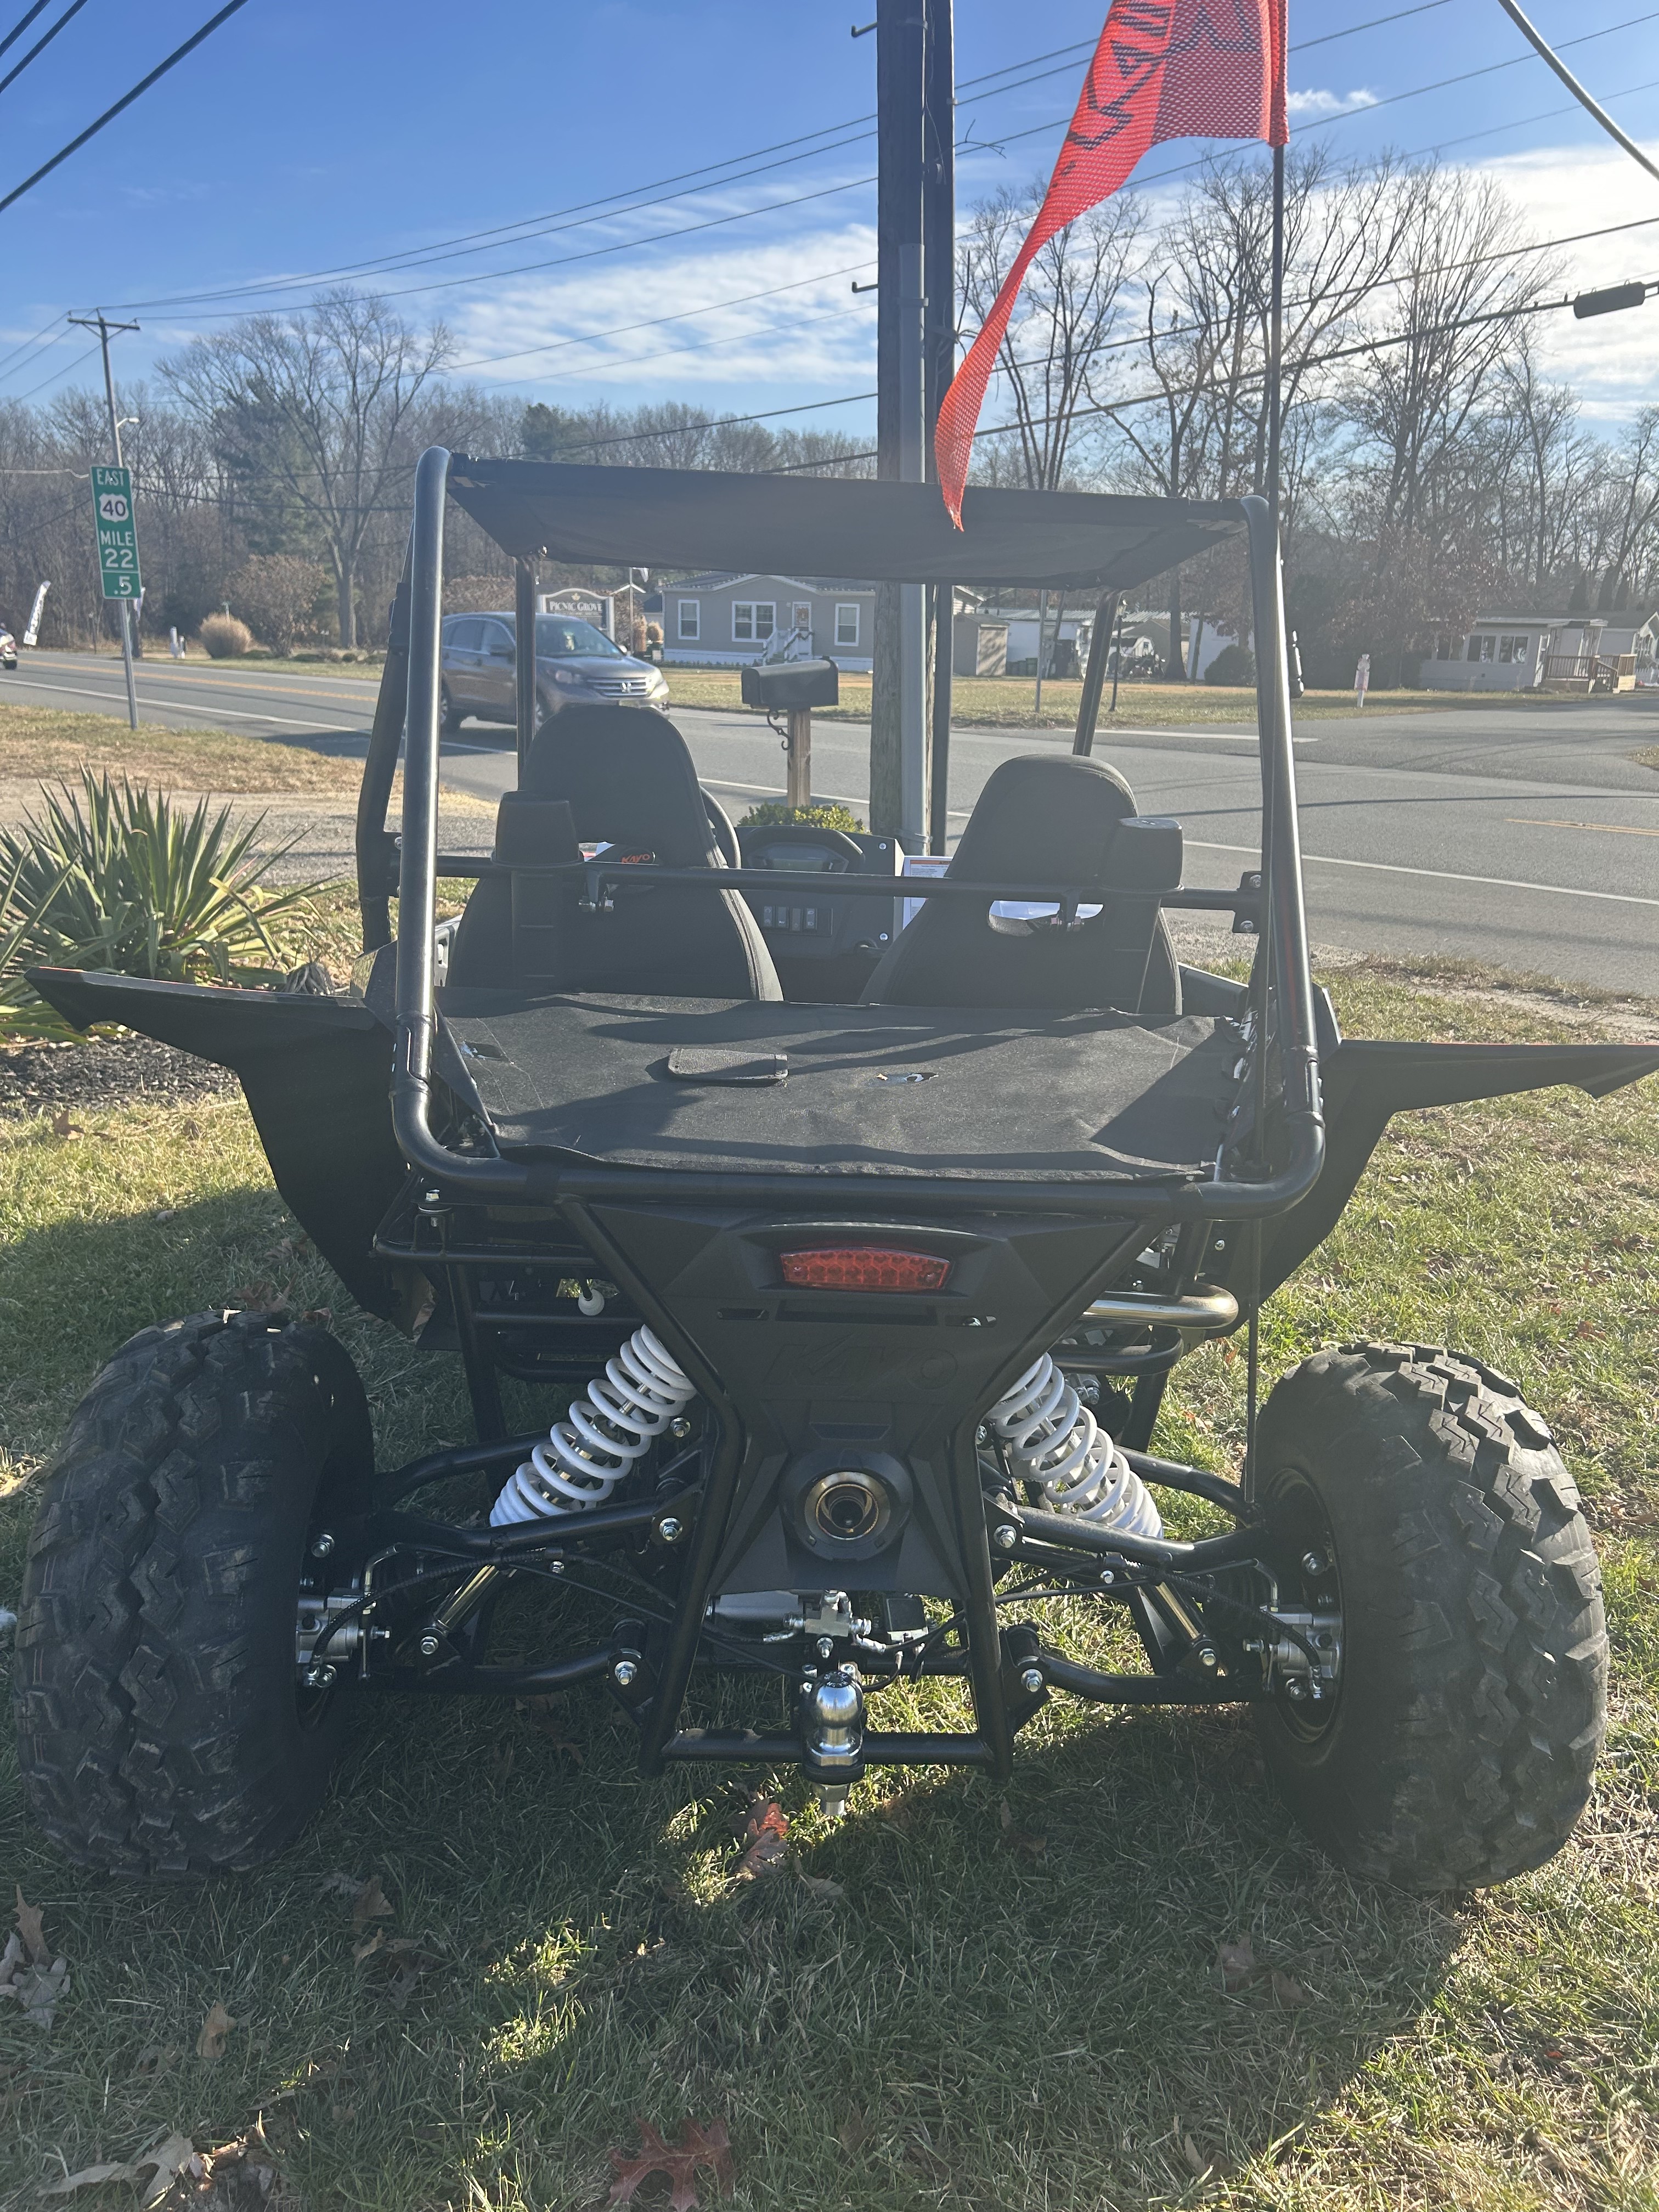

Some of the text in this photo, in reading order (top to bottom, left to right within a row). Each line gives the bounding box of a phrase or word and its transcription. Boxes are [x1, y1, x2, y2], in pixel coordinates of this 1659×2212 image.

[97, 469, 124, 487] EAST
[102, 499, 126, 517] 40
[100, 529, 134, 546] MILE
[104, 548, 134, 568] 22
[114, 576, 132, 595] .5
[577, 601, 602, 612] GROVE
[621, 854, 651, 864] KAYO
